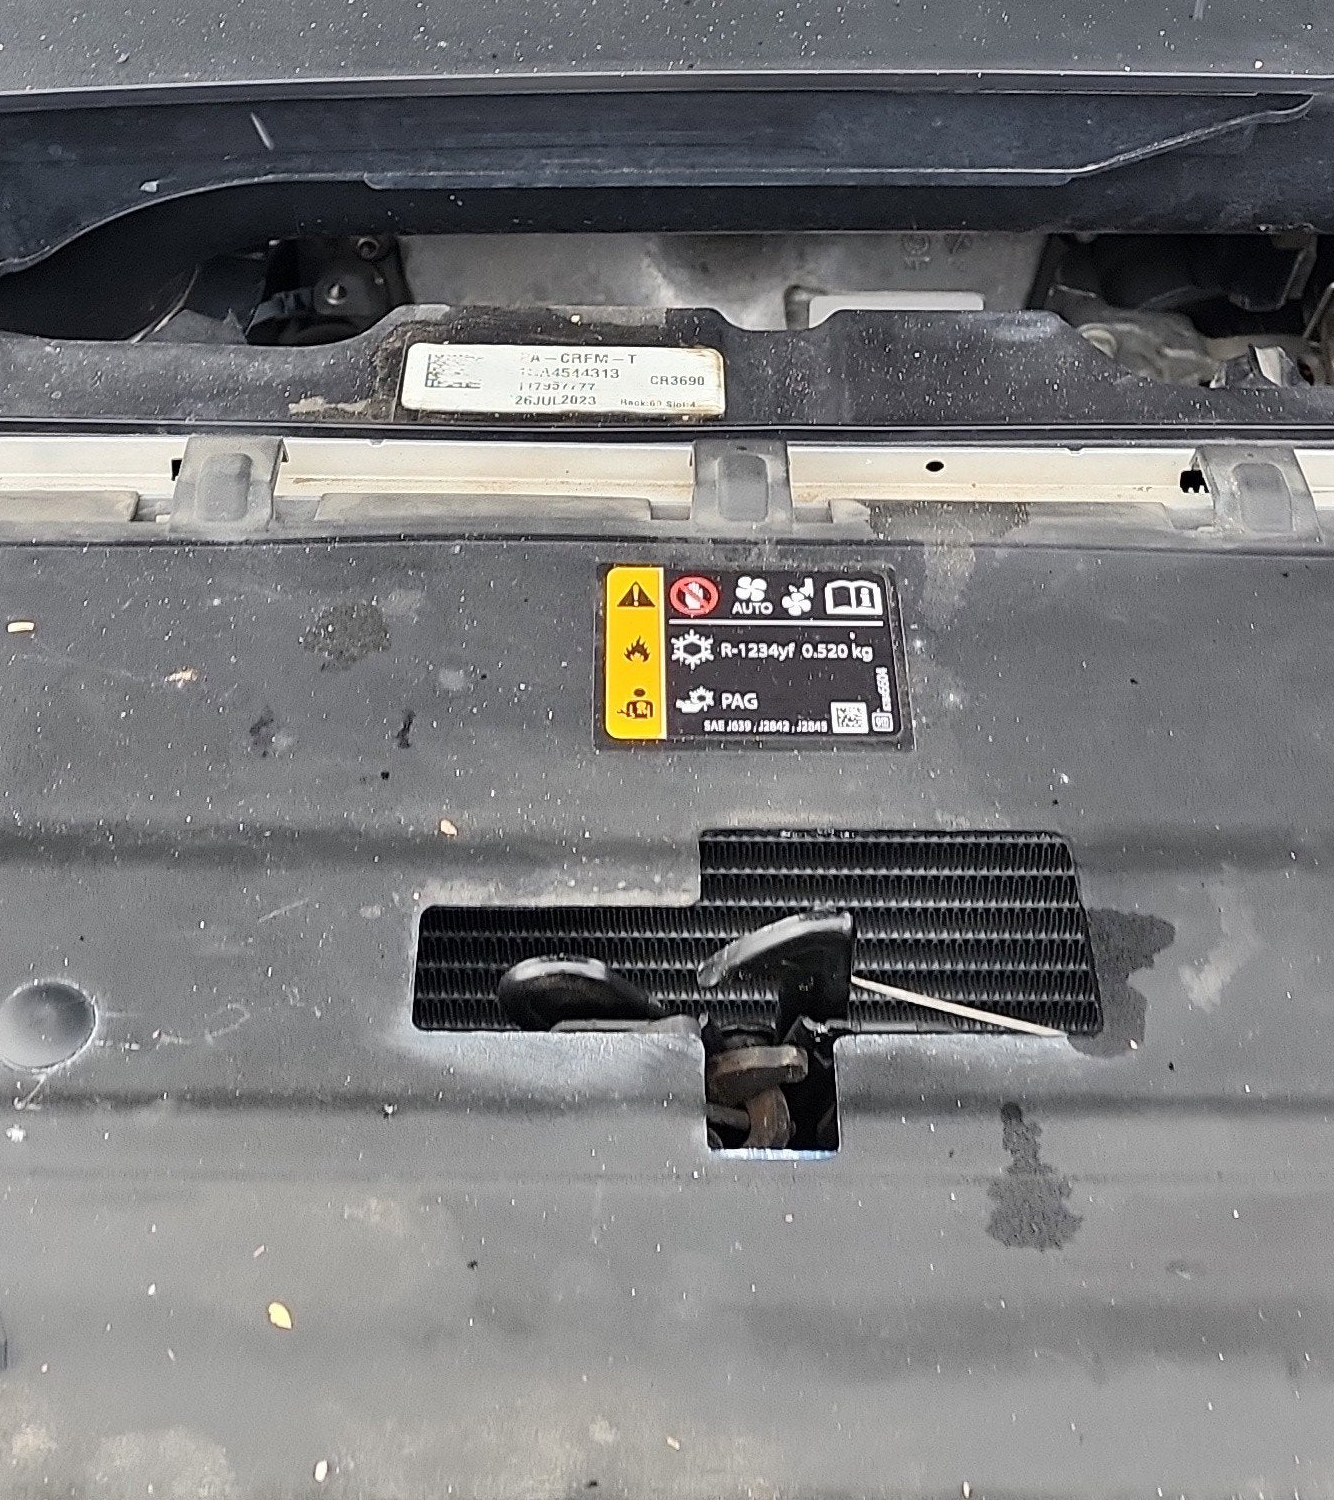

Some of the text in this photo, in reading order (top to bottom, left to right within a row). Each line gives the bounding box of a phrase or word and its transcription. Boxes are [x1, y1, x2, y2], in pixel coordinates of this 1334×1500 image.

[650, 375, 705, 386] CR3690
[515, 395, 597, 406] 26JUL2023
[732, 602, 773, 615] AUTO
[721, 642, 873, 662] R-1234yf 0.520 kg
[721, 692, 758, 710] PAG
[703, 720, 725, 732] SAE
